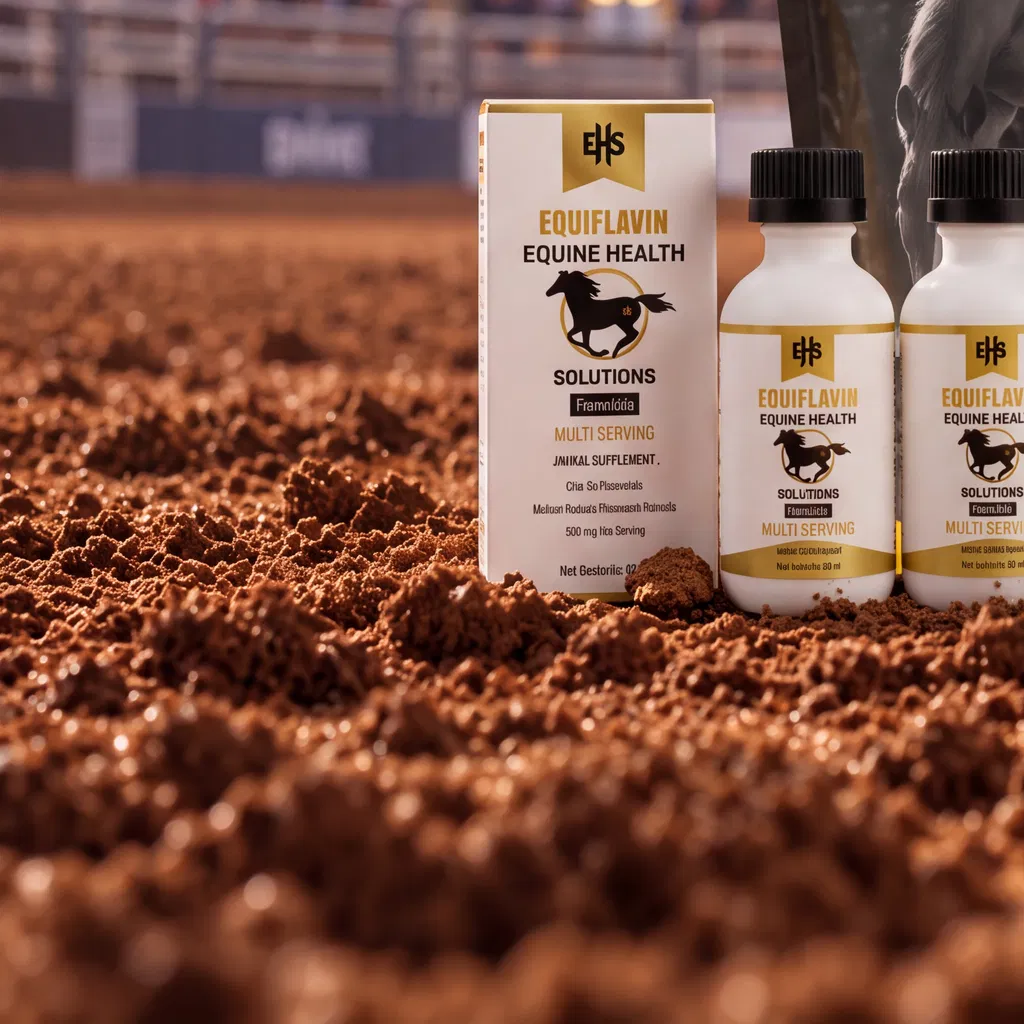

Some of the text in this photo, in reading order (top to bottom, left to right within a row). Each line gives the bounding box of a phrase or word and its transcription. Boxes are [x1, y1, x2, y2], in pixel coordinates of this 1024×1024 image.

[583, 122, 625, 167] EHS
[539, 209, 668, 238] EQUIFLAVIN
[523, 243, 685, 265] EQUINE HEALTH
[553, 368, 656, 386] SOLUTIONS
[759, 412, 857, 428] EQUINE HEALTH
[944, 412, 990, 427] EQUINE
[554, 424, 655, 442] MULTI SERVING
[960, 486, 1024, 499] SOLUTIONS
[565, 526, 582, 537] 500
[583, 528, 598, 539] mg
[615, 525, 646, 538] Serving
[761, 521, 855, 537] MULTI SERVING
[945, 519, 983, 535] MULTI
[560, 565, 577, 577] Net
